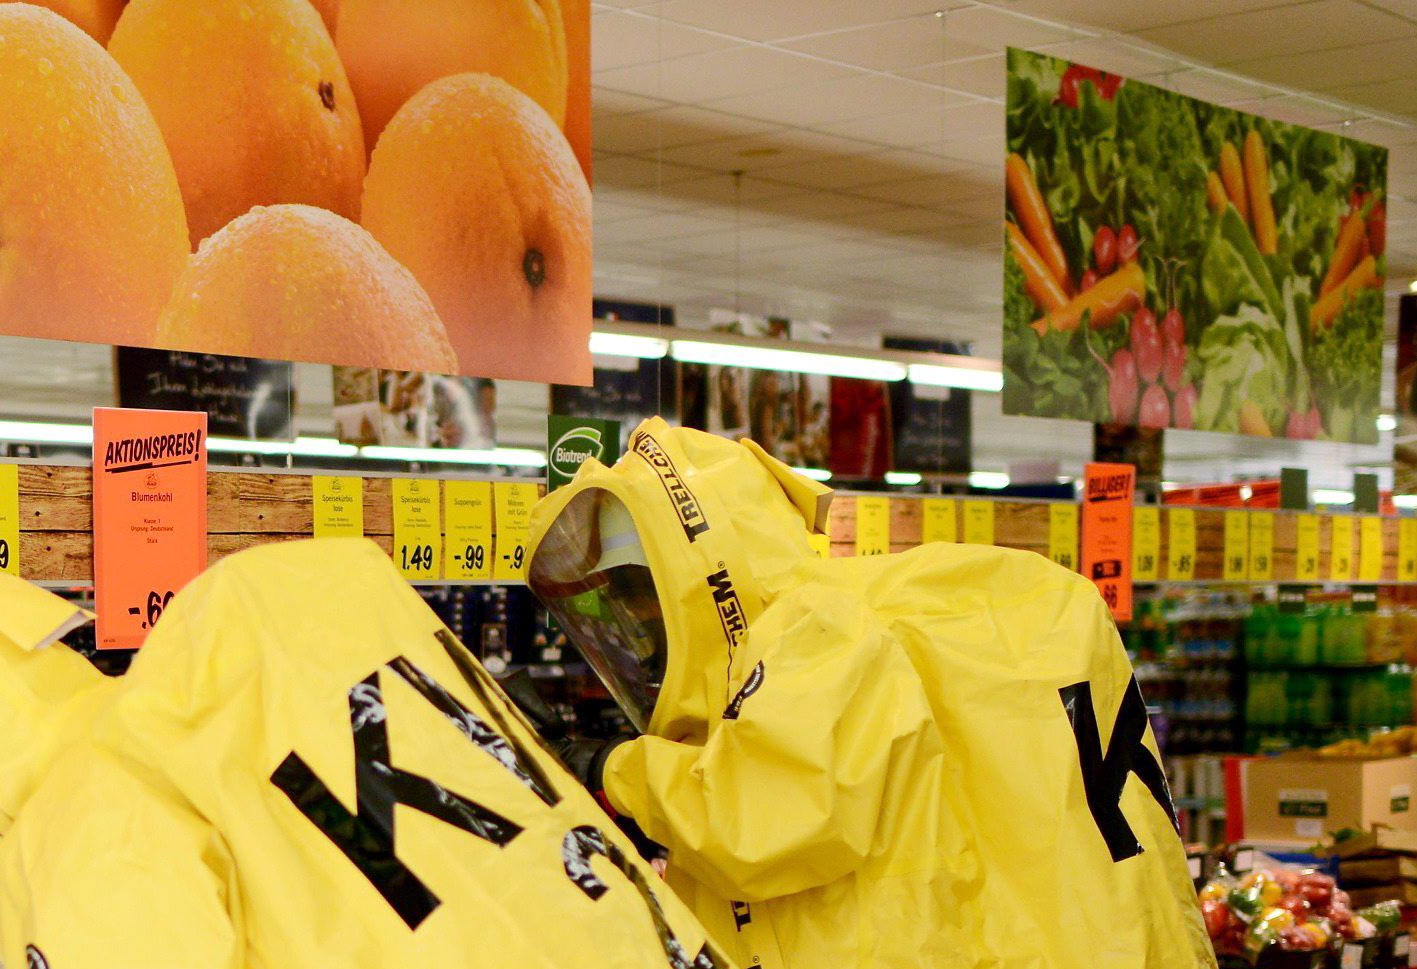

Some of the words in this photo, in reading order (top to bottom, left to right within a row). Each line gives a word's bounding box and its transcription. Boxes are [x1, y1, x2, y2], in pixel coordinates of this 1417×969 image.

[104, 428, 202, 467] AKTIONSPREIS!
[556, 447, 593, 463] Biotrend
[131, 491, 173, 502] Blumenkohl
[402, 544, 433, 571] 1.49
